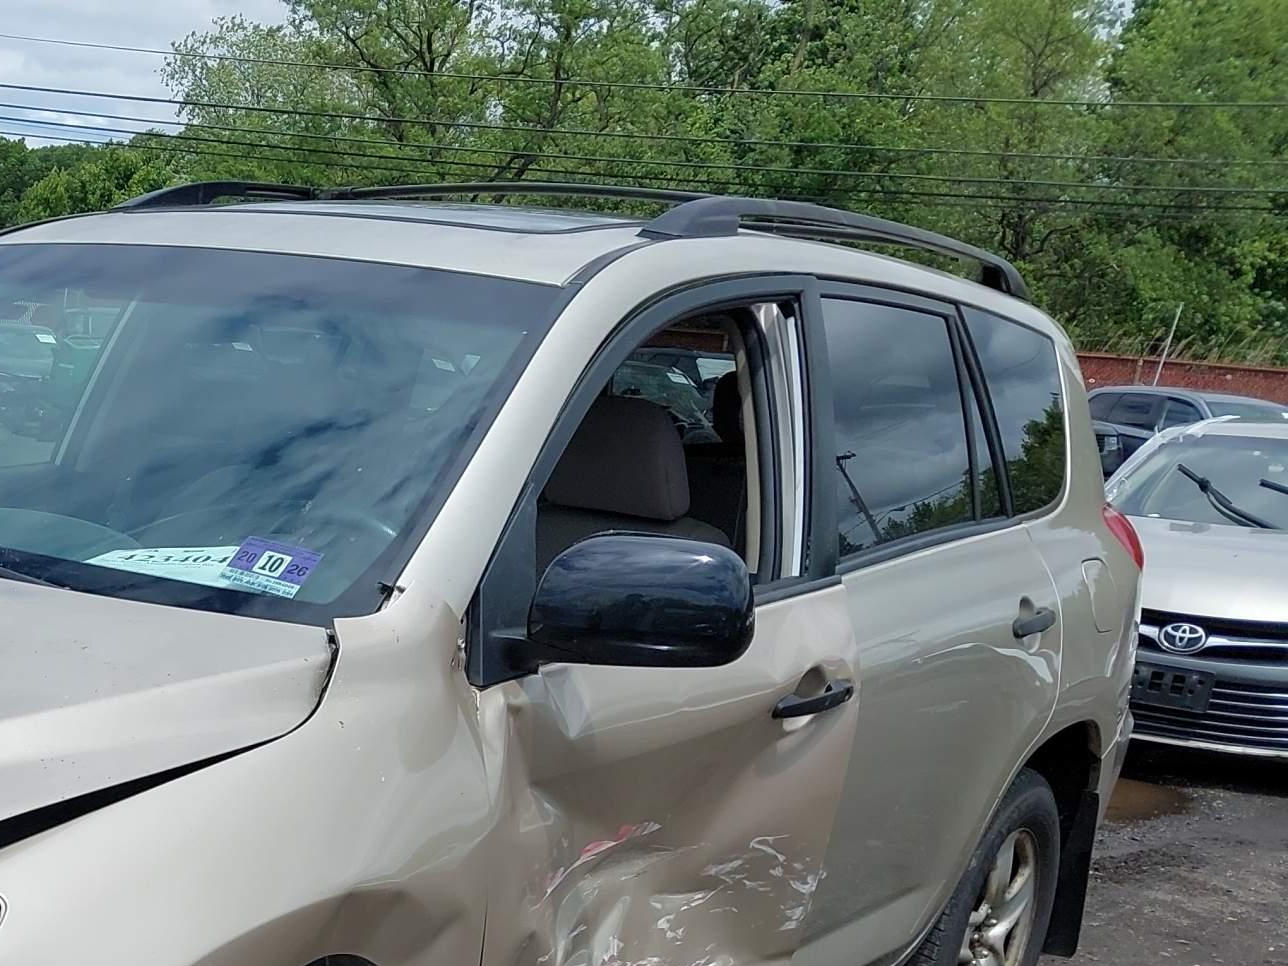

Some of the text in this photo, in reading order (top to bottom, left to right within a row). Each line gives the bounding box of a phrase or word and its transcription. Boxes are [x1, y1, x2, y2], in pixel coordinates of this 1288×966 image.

[238, 550, 309, 577] 20 10 26
